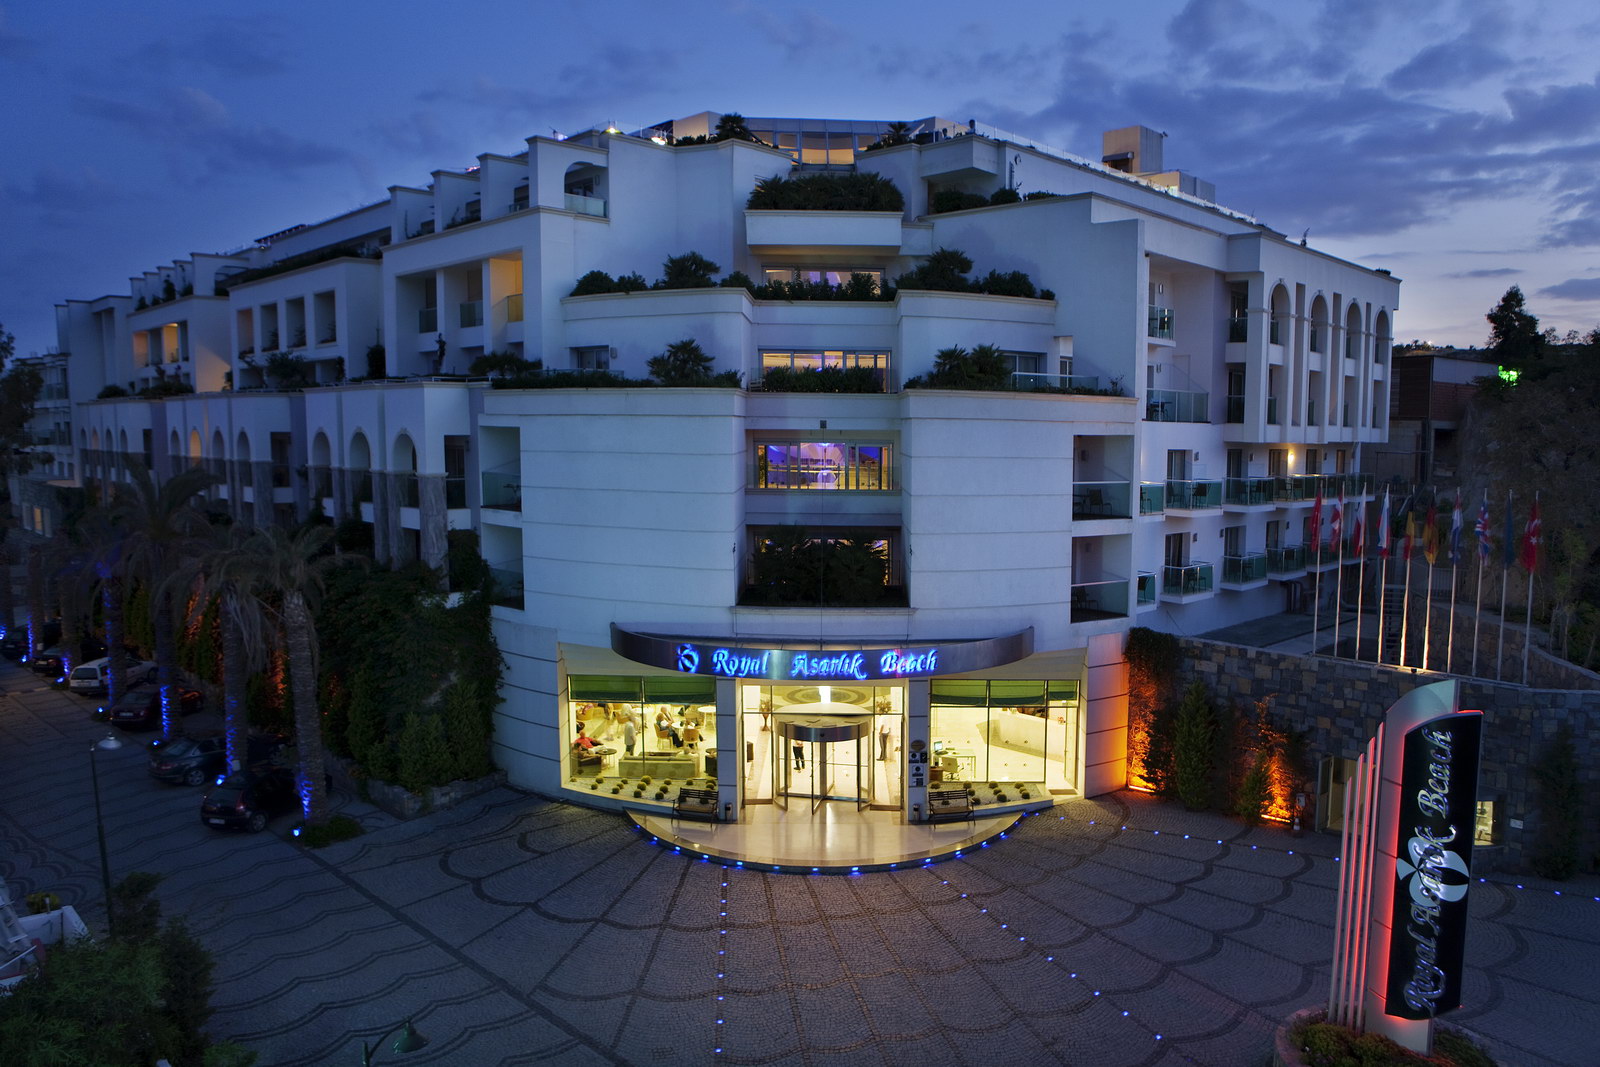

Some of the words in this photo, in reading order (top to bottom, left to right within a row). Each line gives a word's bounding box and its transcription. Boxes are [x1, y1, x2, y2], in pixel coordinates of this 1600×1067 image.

[712, 648, 770, 677] Royal
[880, 649, 938, 674] Beach
[1417, 727, 1453, 819] Beach
[1403, 923, 1446, 1017] Royal
